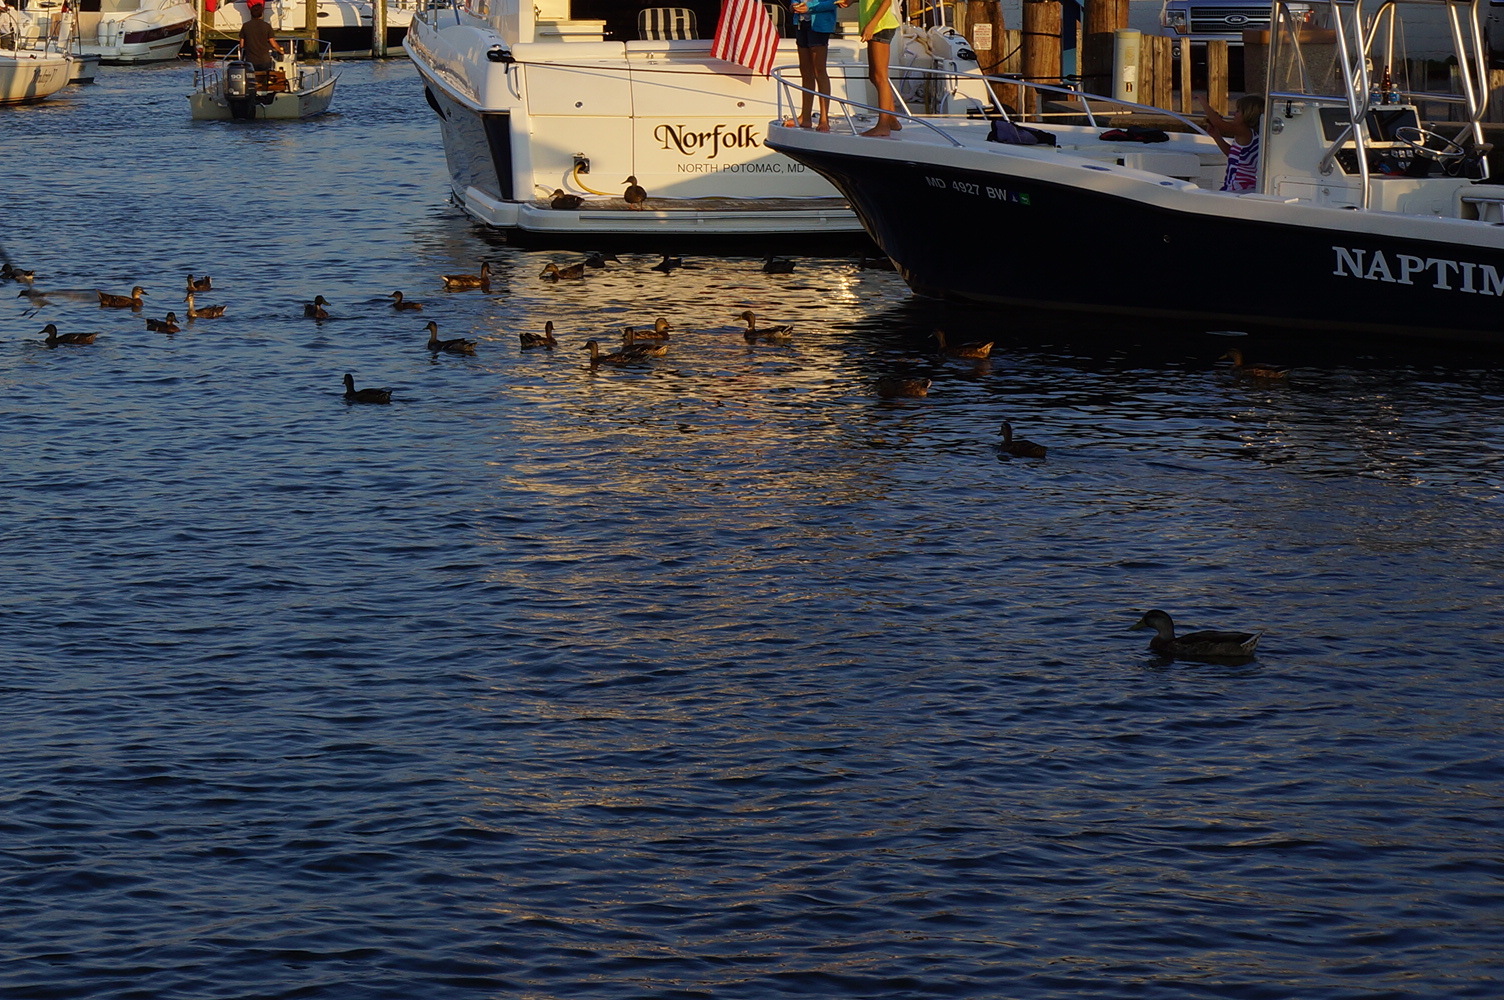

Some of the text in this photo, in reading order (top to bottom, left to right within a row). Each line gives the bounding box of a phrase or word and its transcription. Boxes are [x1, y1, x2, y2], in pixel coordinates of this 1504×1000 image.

[653, 123, 761, 160] Norfolk
[677, 163, 805, 175] NORTH POTOMAC, MD
[925, 175, 1007, 202] MD 4927 BW
